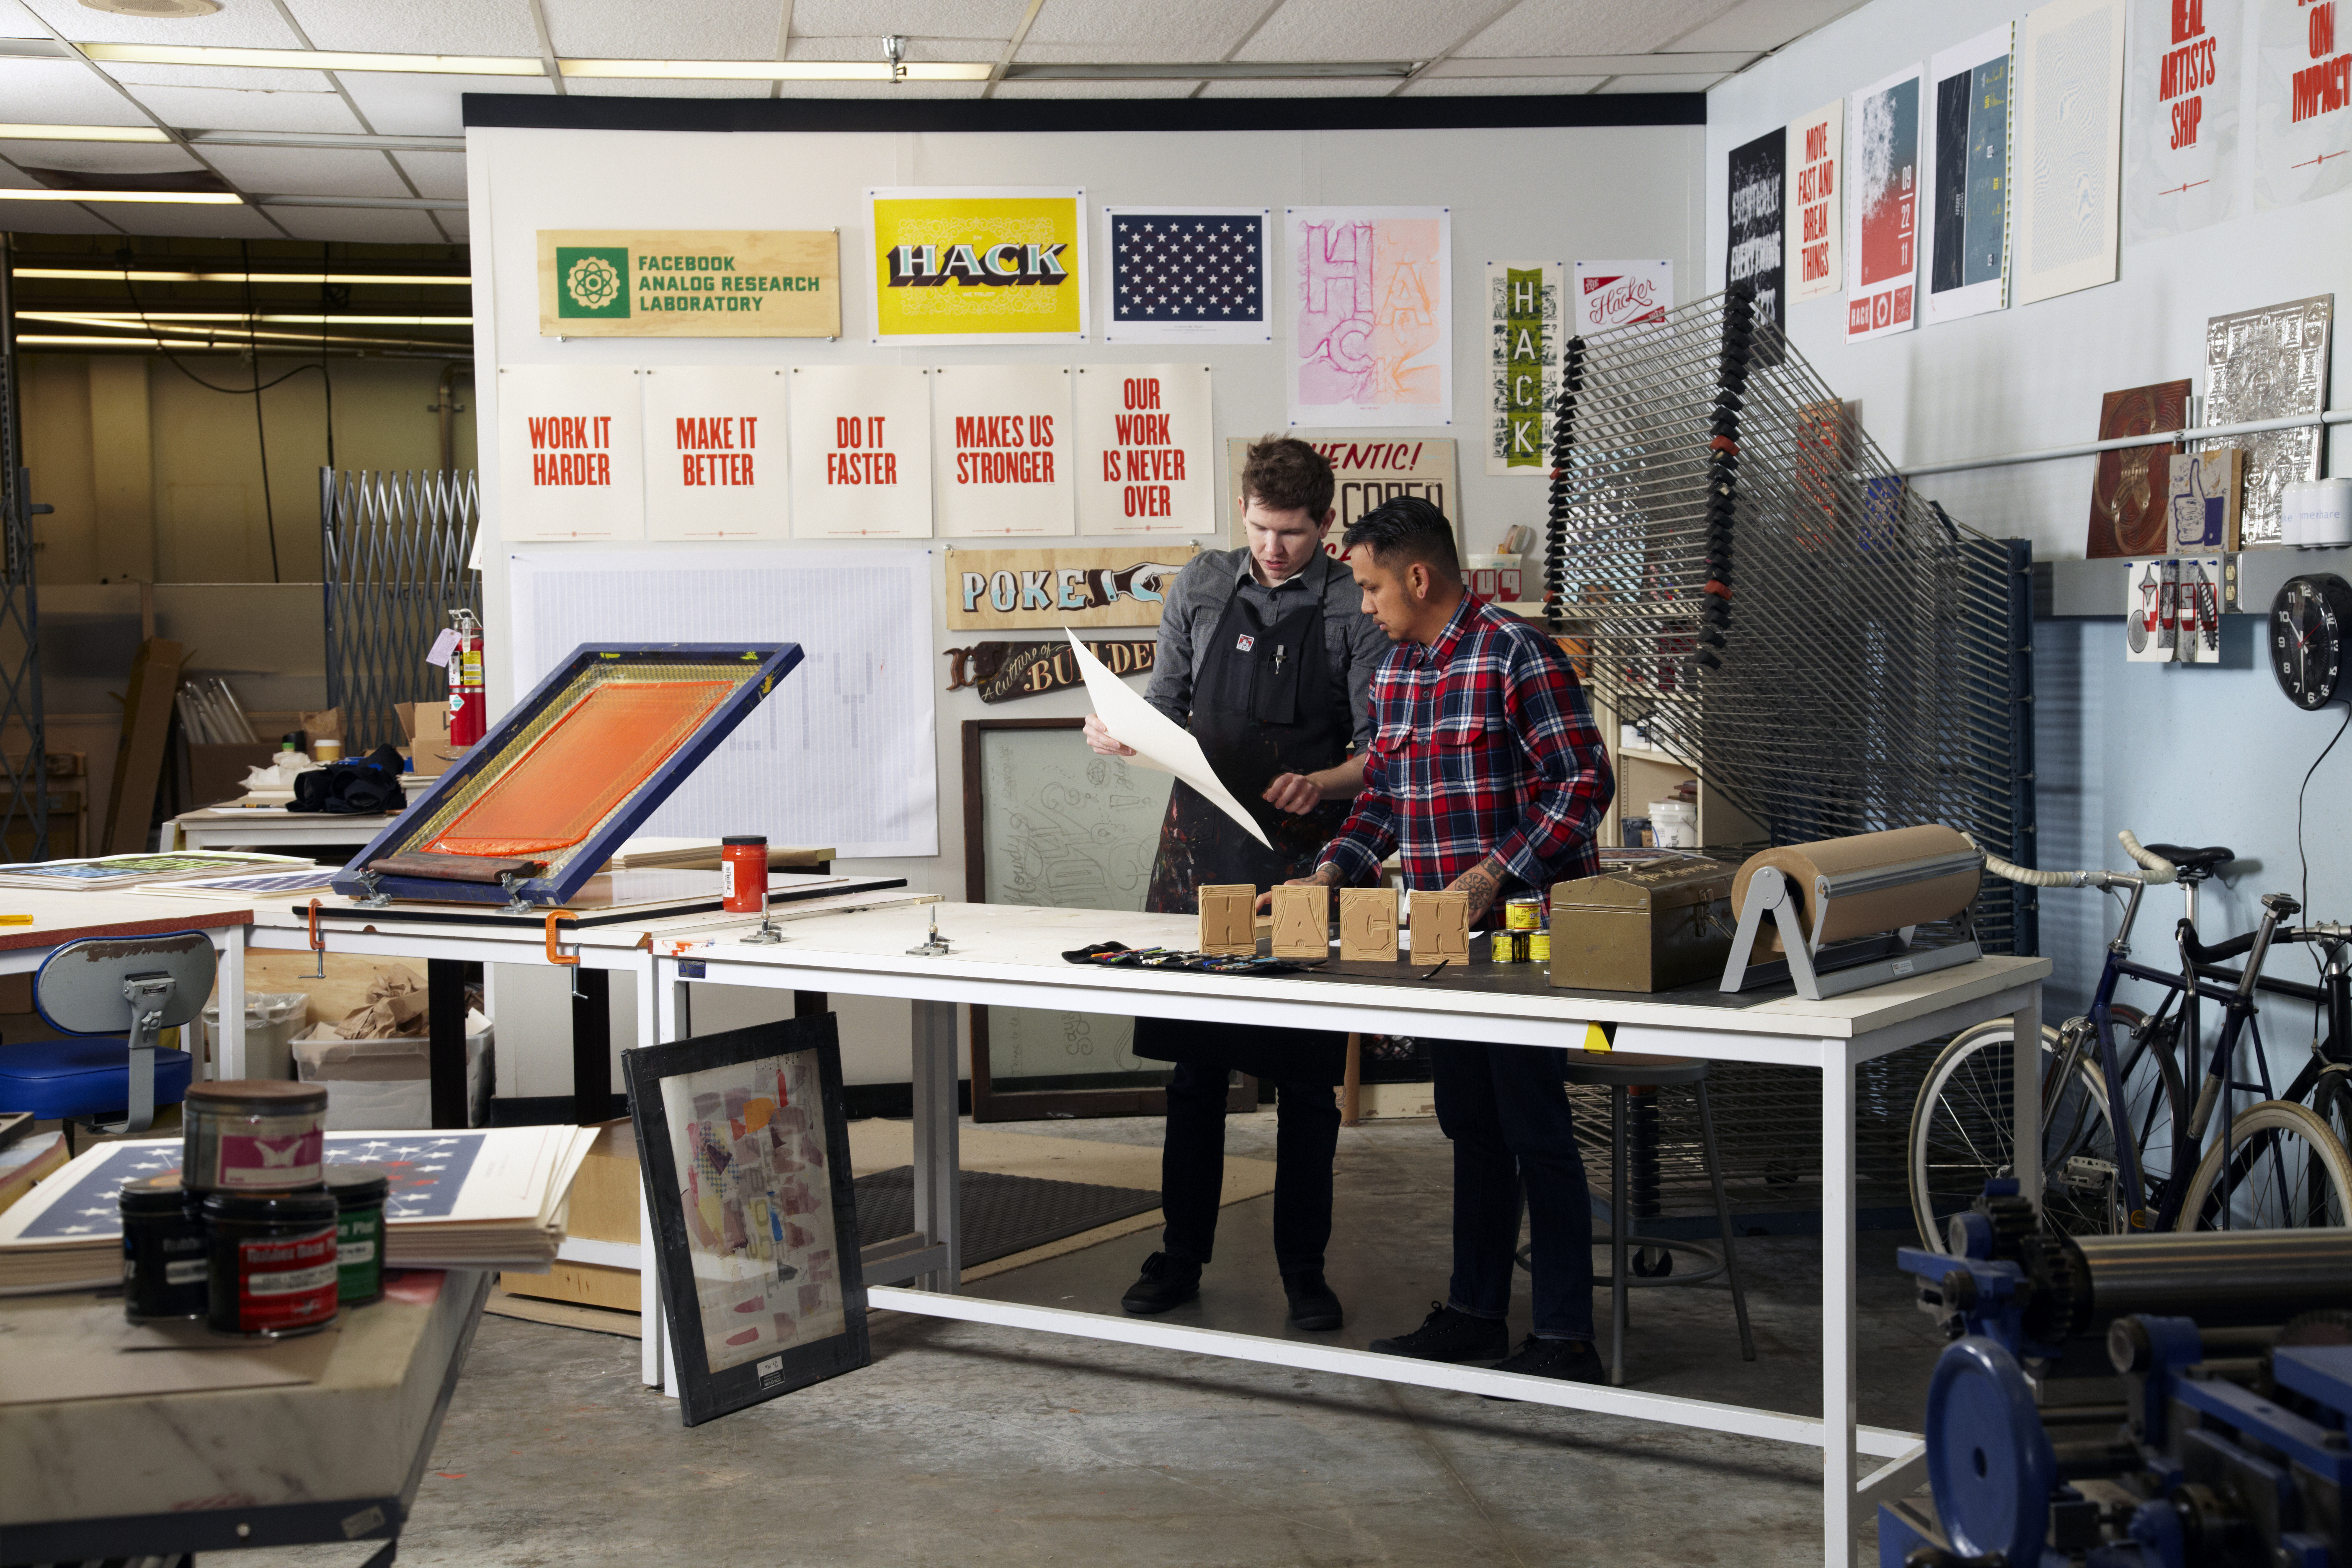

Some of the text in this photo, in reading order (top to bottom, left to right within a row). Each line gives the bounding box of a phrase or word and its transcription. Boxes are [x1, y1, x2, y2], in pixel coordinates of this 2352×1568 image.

[2171, 0, 2206, 45] REAL
[2309, 2, 2333, 59] ON
[2159, 36, 2216, 102] ARTISTS
[2293, 53, 2351, 123] IMPACT
[2171, 96, 2202, 150] SHIP
[1806, 122, 1827, 163] MOVE
[1798, 160, 1833, 205] FAST AND
[1902, 165, 1911, 191] 09
[1804, 203, 1827, 242] BREAK
[1901, 204, 1910, 229] 22
[639, 256, 735, 271] FACEBOOK
[886, 242, 1068, 287] HACK
[1802, 242, 1828, 281] THINGS
[1901, 242, 1907, 266] 11
[639, 276, 820, 291] ANALOG RESEARCH
[640, 296, 763, 311] LABORATORY
[1589, 276, 1657, 325] Hacker
[1852, 304, 1870, 327] HACK
[1124, 378, 1160, 410] OUR
[529, 417, 611, 449] WORK IT
[677, 417, 757, 449] MAKE IT
[837, 417, 885, 448] DO IT
[956, 415, 1053, 448] MAKES US
[1115, 414, 1171, 445] WORK
[534, 454, 610, 485] HARDER
[683, 454, 754, 485] BETTER
[828, 453, 897, 485] FASTER
[957, 451, 1054, 484] STRONGER
[1104, 449, 1185, 482] IS NEVER
[1309, 442, 1423, 471] ENTIC!
[1124, 485, 1171, 517] OVER
[2318, 510, 2340, 519] hare
[961, 570, 1089, 612] POKE
[2288, 592, 2295, 603] 11
[2300, 585, 2311, 596] 12
[2279, 611, 2289, 622] 10
[2278, 637, 2285, 647] 9
[981, 642, 1057, 701] A Culture of
[1024, 641, 1157, 692] BULDE
[2284, 662, 2290, 673] 8
[2294, 682, 2300, 693] 7
[2308, 692, 2315, 704] 6
